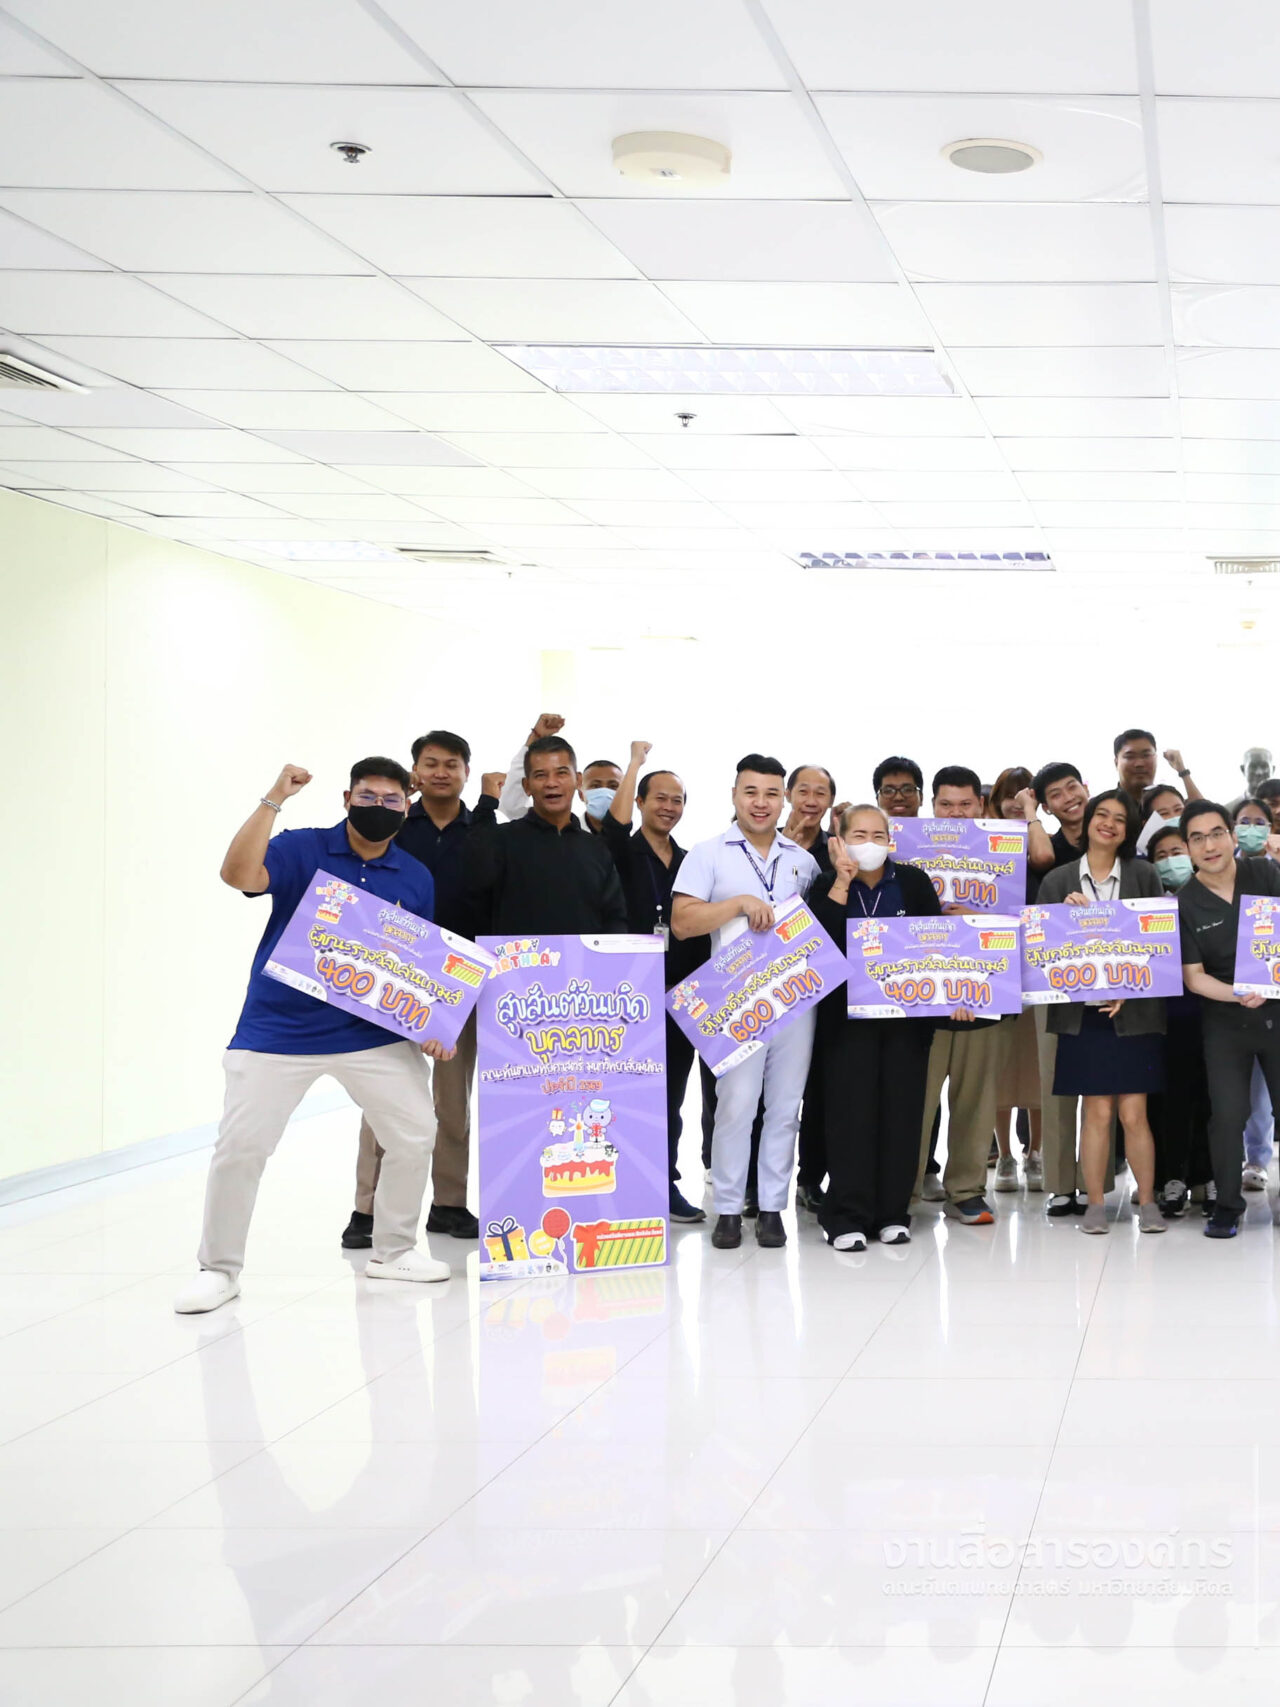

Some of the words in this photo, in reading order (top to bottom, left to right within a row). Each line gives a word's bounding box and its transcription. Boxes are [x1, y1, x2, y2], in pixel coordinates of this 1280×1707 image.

[952, 877, 997, 905] บาท
[496, 938, 539, 958] HAPPY
[1025, 939, 1173, 967] ผู้โชคดีรางวัลจับฉลาก
[309, 925, 464, 1006] ผู้ชนะรางวัลเล่นเกมส์
[865, 955, 1010, 980] ผู้ชนะรางวัลเล่นเกมส์
[1049, 962, 1097, 988] 600
[1104, 962, 1151, 989] บาท
[317, 956, 376, 998] 400
[380, 983, 432, 1032] บาท
[698, 937, 823, 1036] ผู้โชคดีรางวัลจับฉลาก
[884, 977, 936, 1003] 400
[943, 977, 992, 1005] บาท
[498, 979, 650, 1037] สุขสันต์วันเกิด
[729, 998, 775, 1043] 600
[773, 969, 823, 1006] บาท
[526, 1026, 626, 1063] บุคลากร
